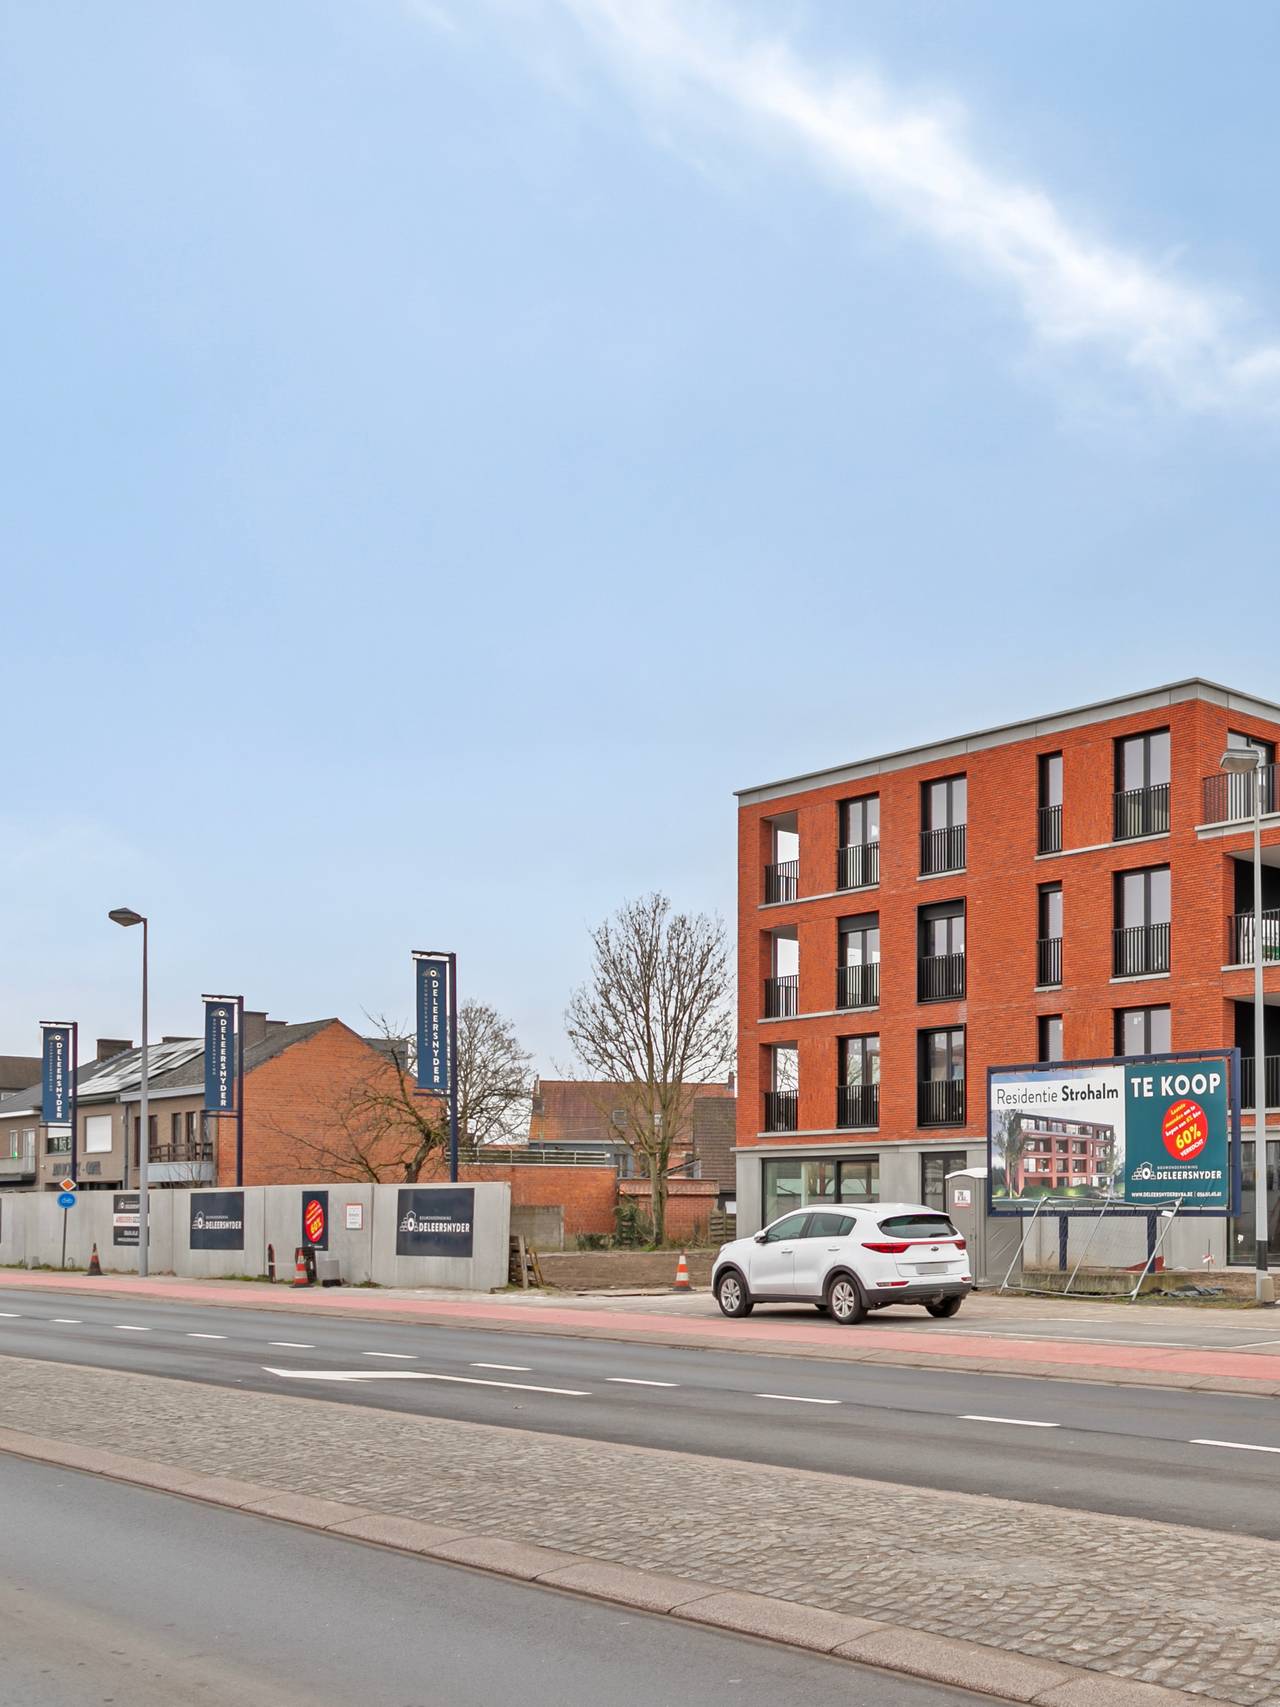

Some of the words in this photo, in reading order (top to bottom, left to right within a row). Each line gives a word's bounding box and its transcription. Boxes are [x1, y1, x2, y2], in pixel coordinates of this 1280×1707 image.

[432, 980, 440, 1083] DELEERSNYDER
[996, 1087, 1058, 1105] Residentie
[1061, 1082, 1119, 1102] Strohalm
[1130, 1077, 1154, 1098] TE
[1161, 1073, 1221, 1096] KOOP
[1175, 1123, 1202, 1150] 60%
[1156, 1170, 1222, 1180] DELEERSNYDER
[418, 1222, 470, 1233] DELEERSNYDER
